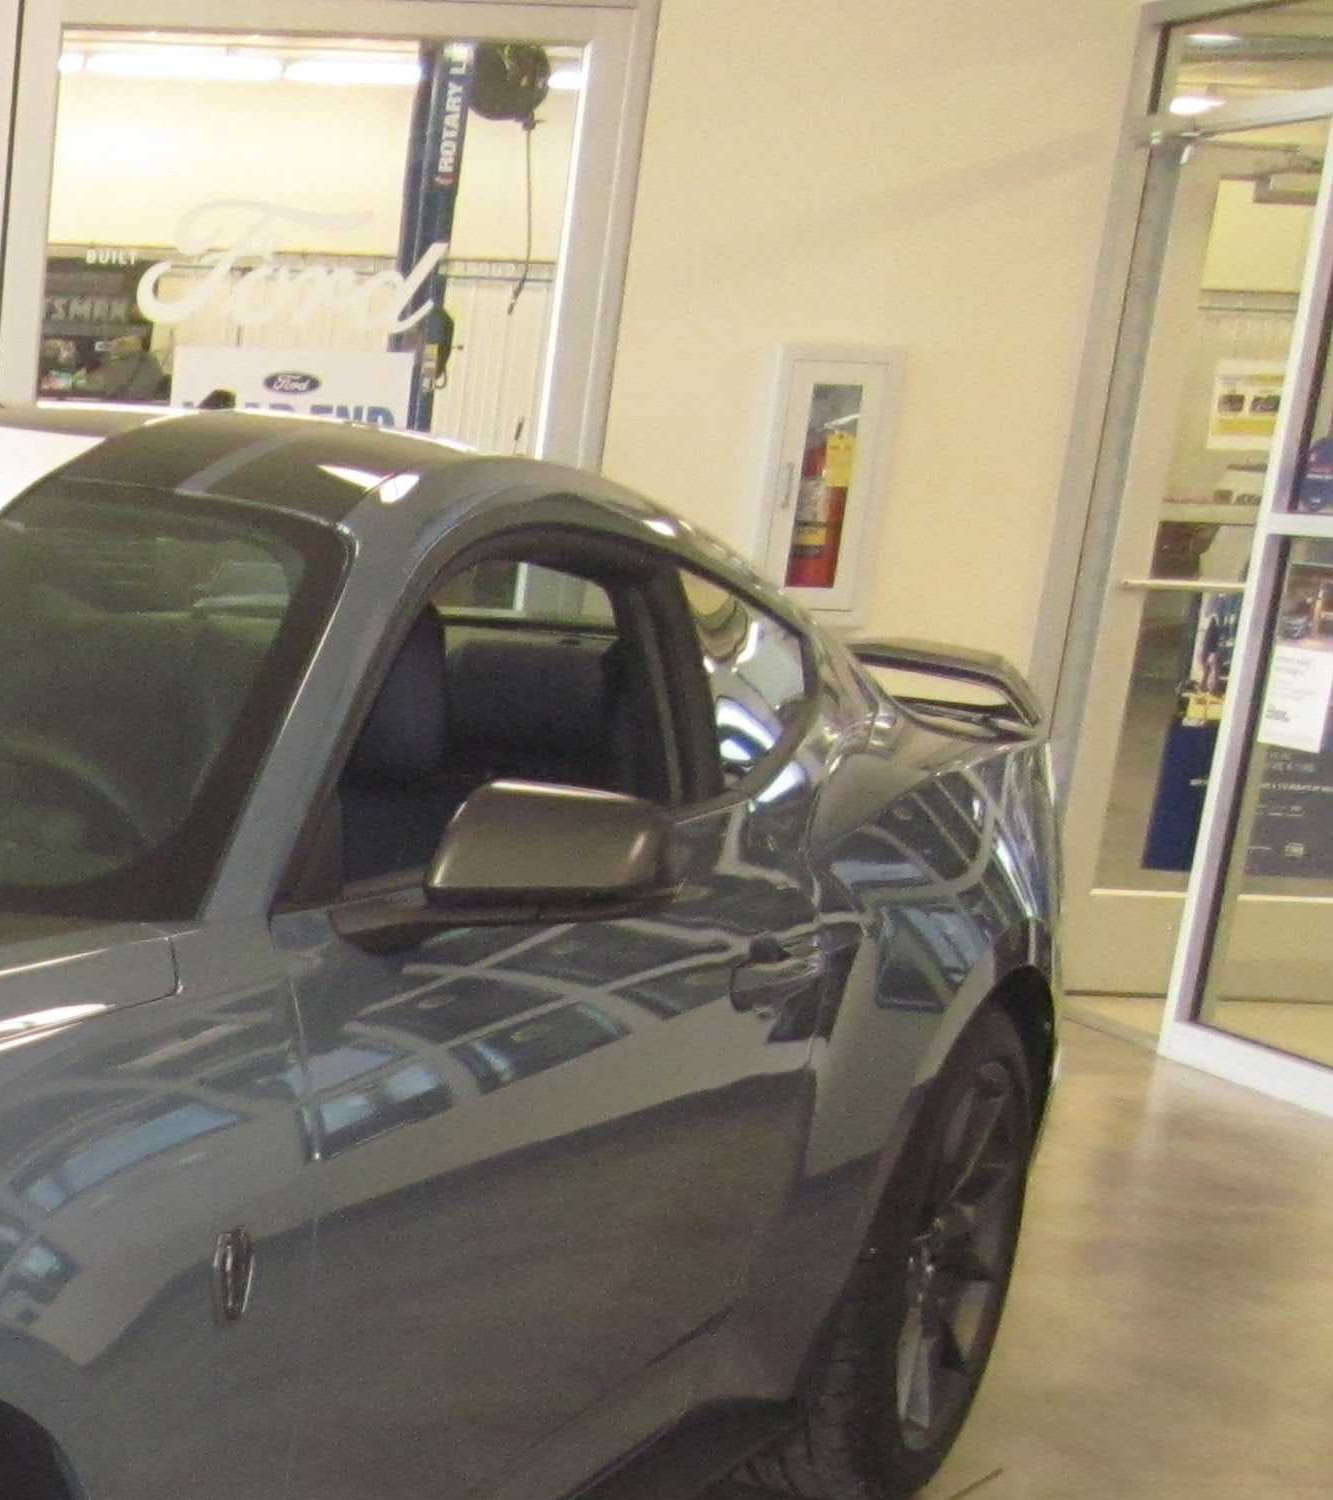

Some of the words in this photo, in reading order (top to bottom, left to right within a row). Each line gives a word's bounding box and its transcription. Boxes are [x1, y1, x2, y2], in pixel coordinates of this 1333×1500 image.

[438, 81, 463, 173] ROTARY
[84, 248, 138, 268] BUILT
[136, 200, 449, 334] Ford
[270, 373, 316, 392] Ford
